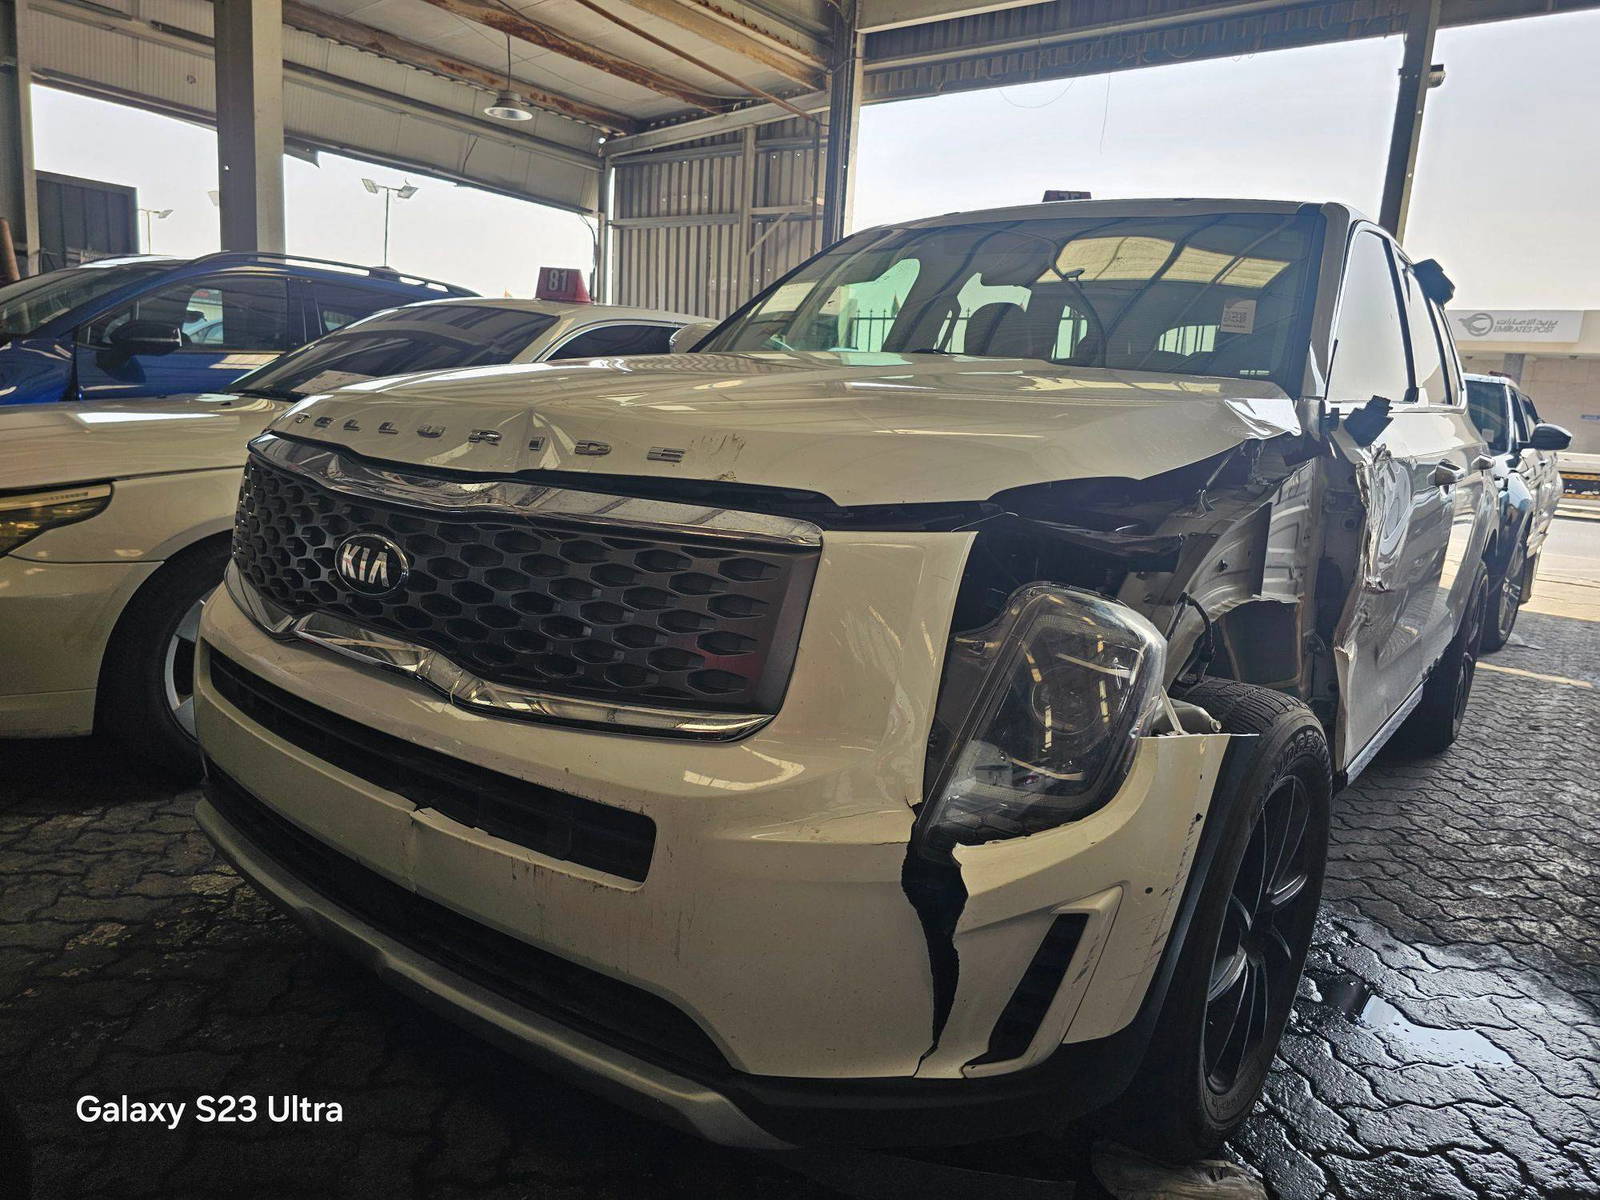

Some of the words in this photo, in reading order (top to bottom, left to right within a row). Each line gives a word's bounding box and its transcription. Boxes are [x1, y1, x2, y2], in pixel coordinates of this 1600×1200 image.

[549, 269, 568, 291] 81
[1494, 325, 1532, 333] EMIRATES
[1533, 326, 1556, 334] POST
[294, 411, 687, 463] TELLURIDE
[341, 543, 390, 588] KIA
